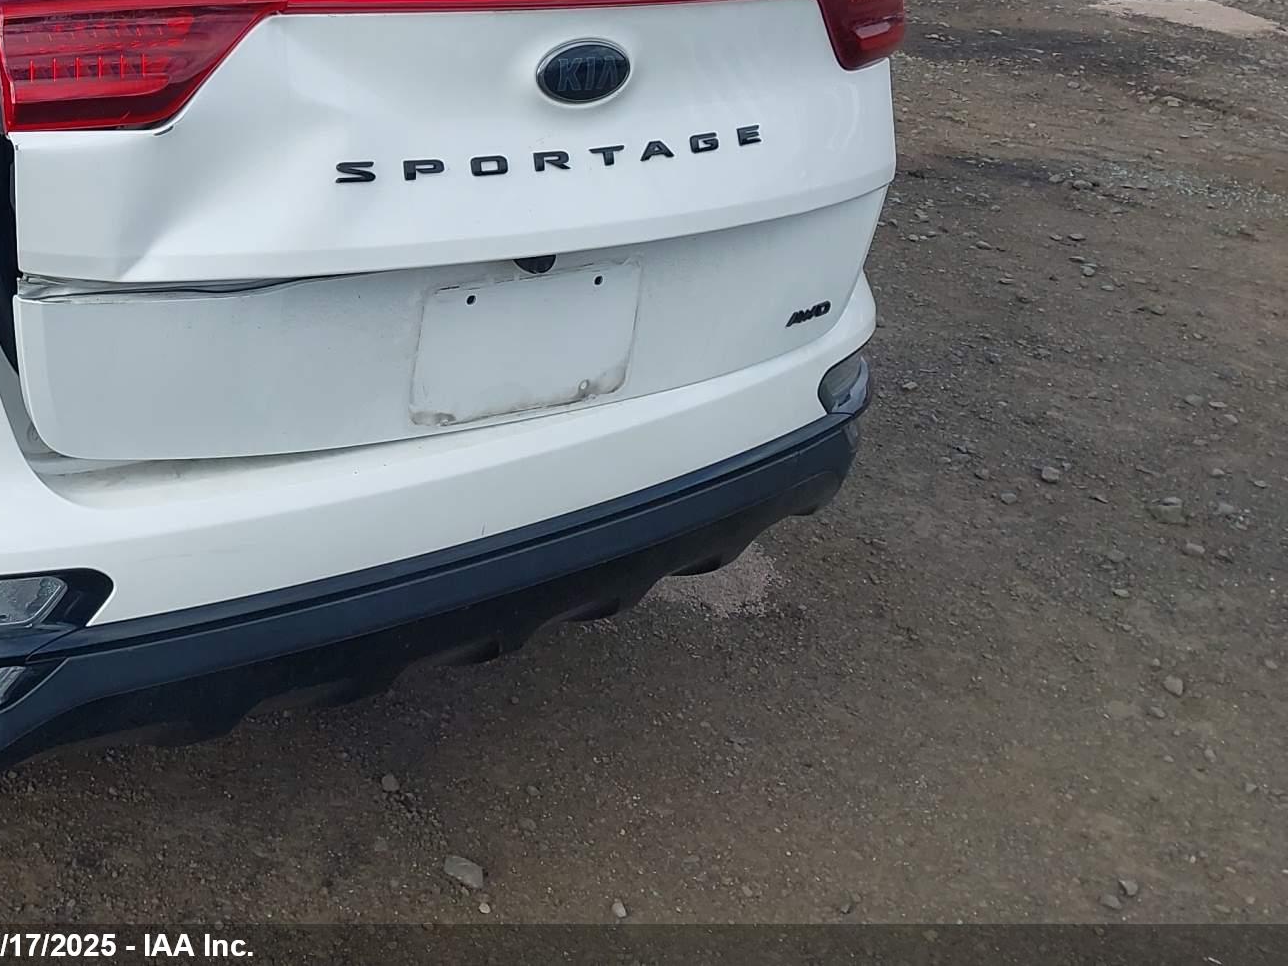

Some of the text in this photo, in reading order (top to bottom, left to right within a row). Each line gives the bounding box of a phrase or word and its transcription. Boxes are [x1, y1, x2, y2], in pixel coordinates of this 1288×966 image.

[557, 55, 618, 91] KIA
[335, 124, 763, 183] SPORTAGE
[785, 300, 831, 327] AWD
